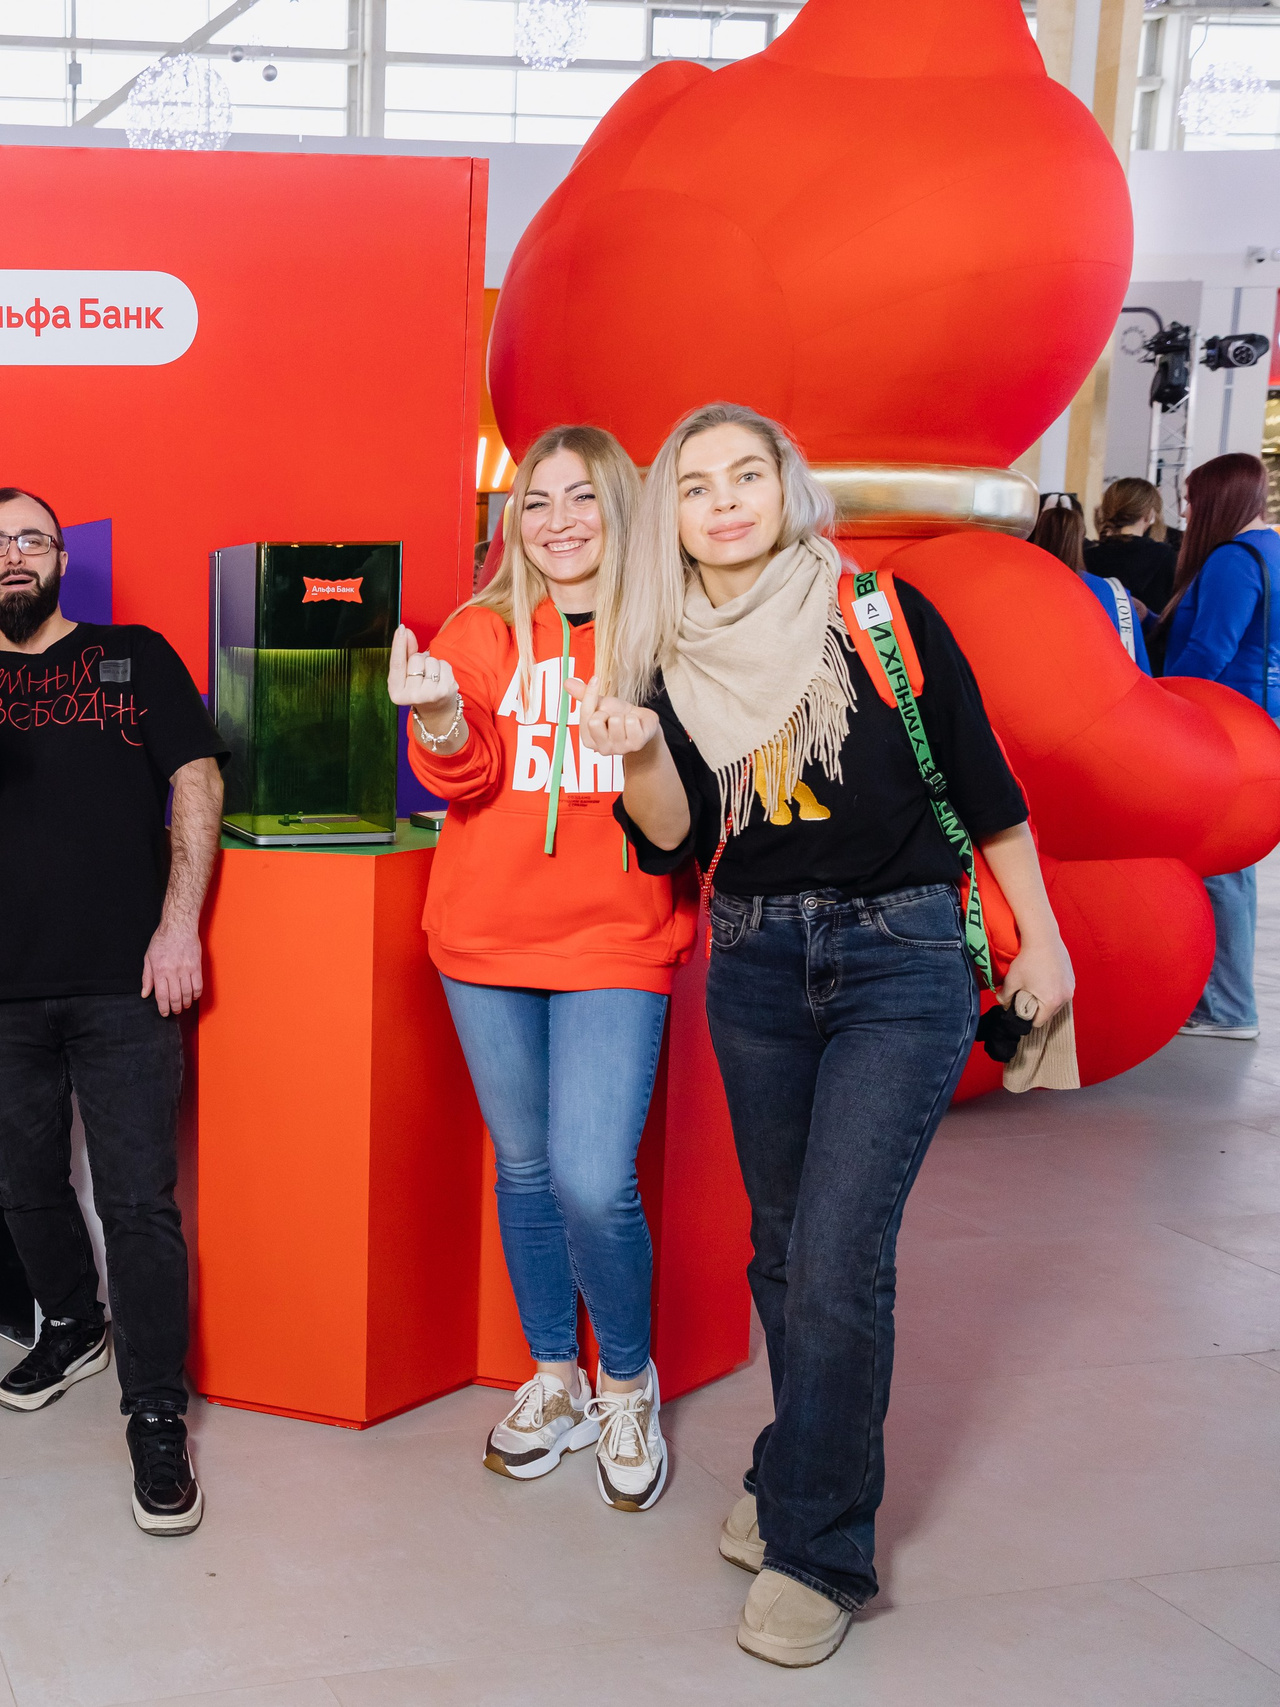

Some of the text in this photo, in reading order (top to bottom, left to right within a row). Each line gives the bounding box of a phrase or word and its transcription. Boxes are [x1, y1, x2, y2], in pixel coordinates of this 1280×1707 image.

[79, 298, 164, 329] Банк
[311, 585, 335, 595] Альфа
[1116, 597, 1132, 634] LOVE
[496, 656, 586, 726] АЛЬ
[879, 645, 925, 753] УМНЫХ
[511, 723, 625, 793] БАН
